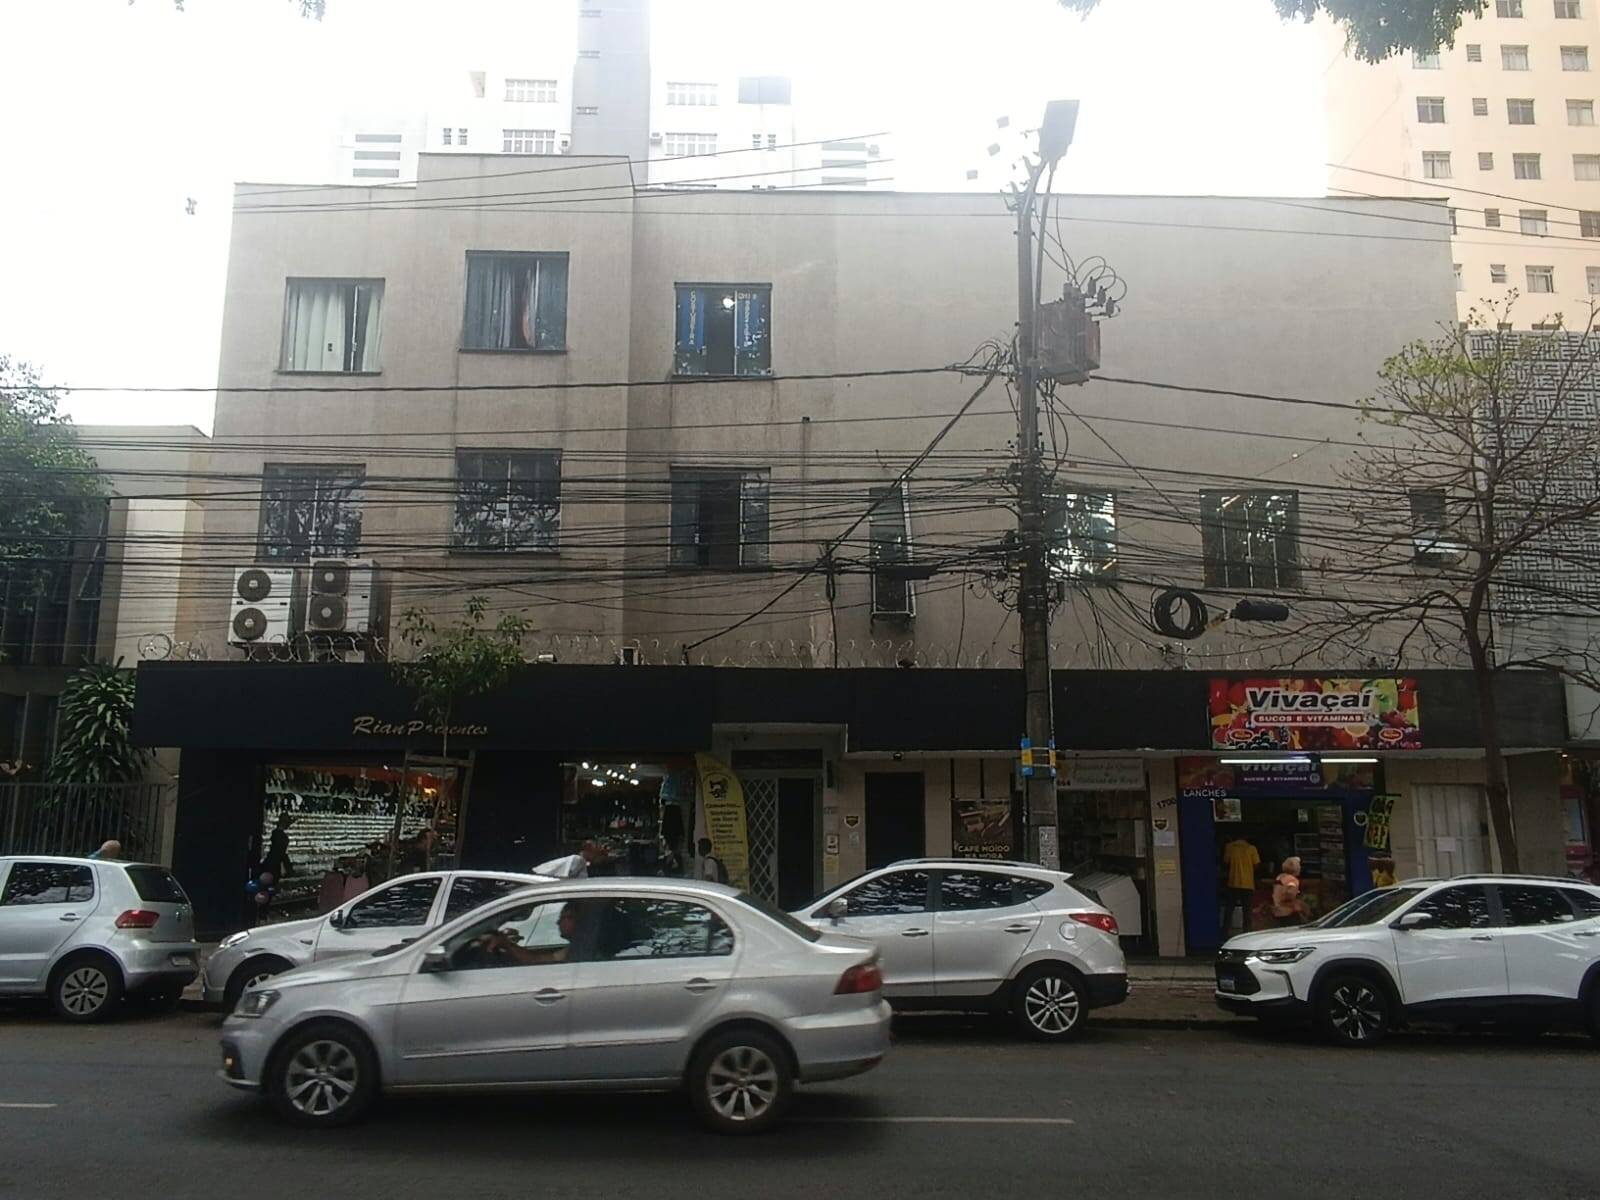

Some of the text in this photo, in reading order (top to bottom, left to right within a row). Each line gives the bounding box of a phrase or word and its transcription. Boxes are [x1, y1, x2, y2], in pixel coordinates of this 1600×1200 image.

[1248, 689, 1373, 712] Vivaçaí
[352, 716, 405, 735] Rian
[1258, 715, 1362, 723] SUCOS E VITAMINAS
[1182, 788, 1227, 798] LANCHES
